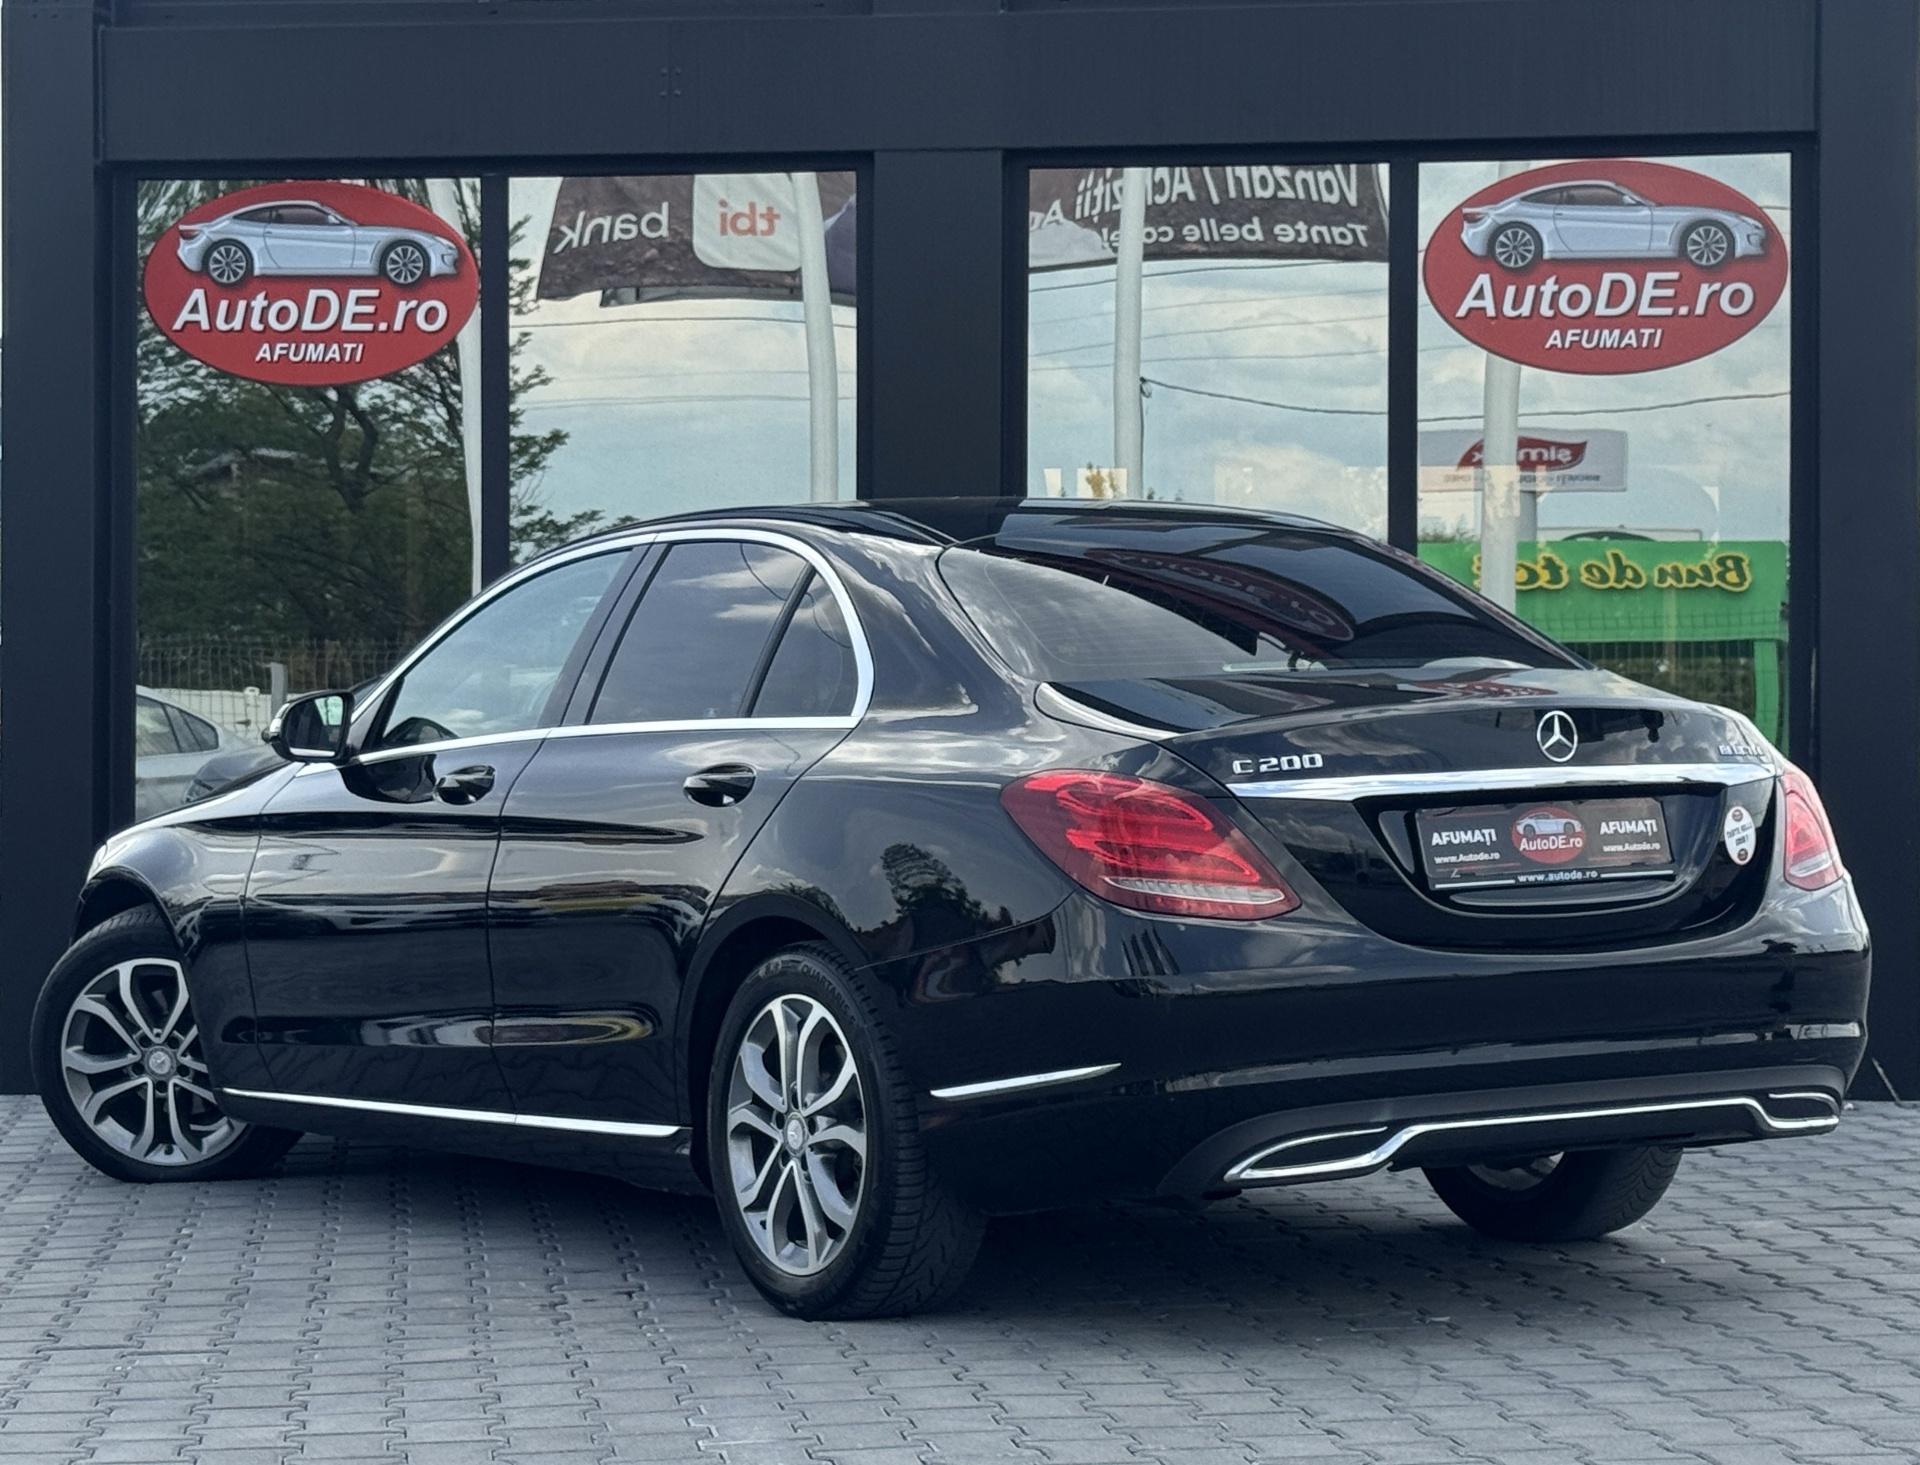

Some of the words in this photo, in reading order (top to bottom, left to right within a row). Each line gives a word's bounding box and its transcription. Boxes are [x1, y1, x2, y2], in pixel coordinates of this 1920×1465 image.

[1456, 271, 1755, 318] AutoDE.ro
[172, 288, 448, 332] AutoDE.ro
[1545, 329, 1663, 349] AFUMATI
[255, 343, 364, 363] AFUMATI
[1232, 760, 1254, 774] C
[1258, 753, 1323, 773] 200
[1519, 835, 1583, 852] AutoDE.ro
[1517, 869, 1598, 882] www.autode.ro
